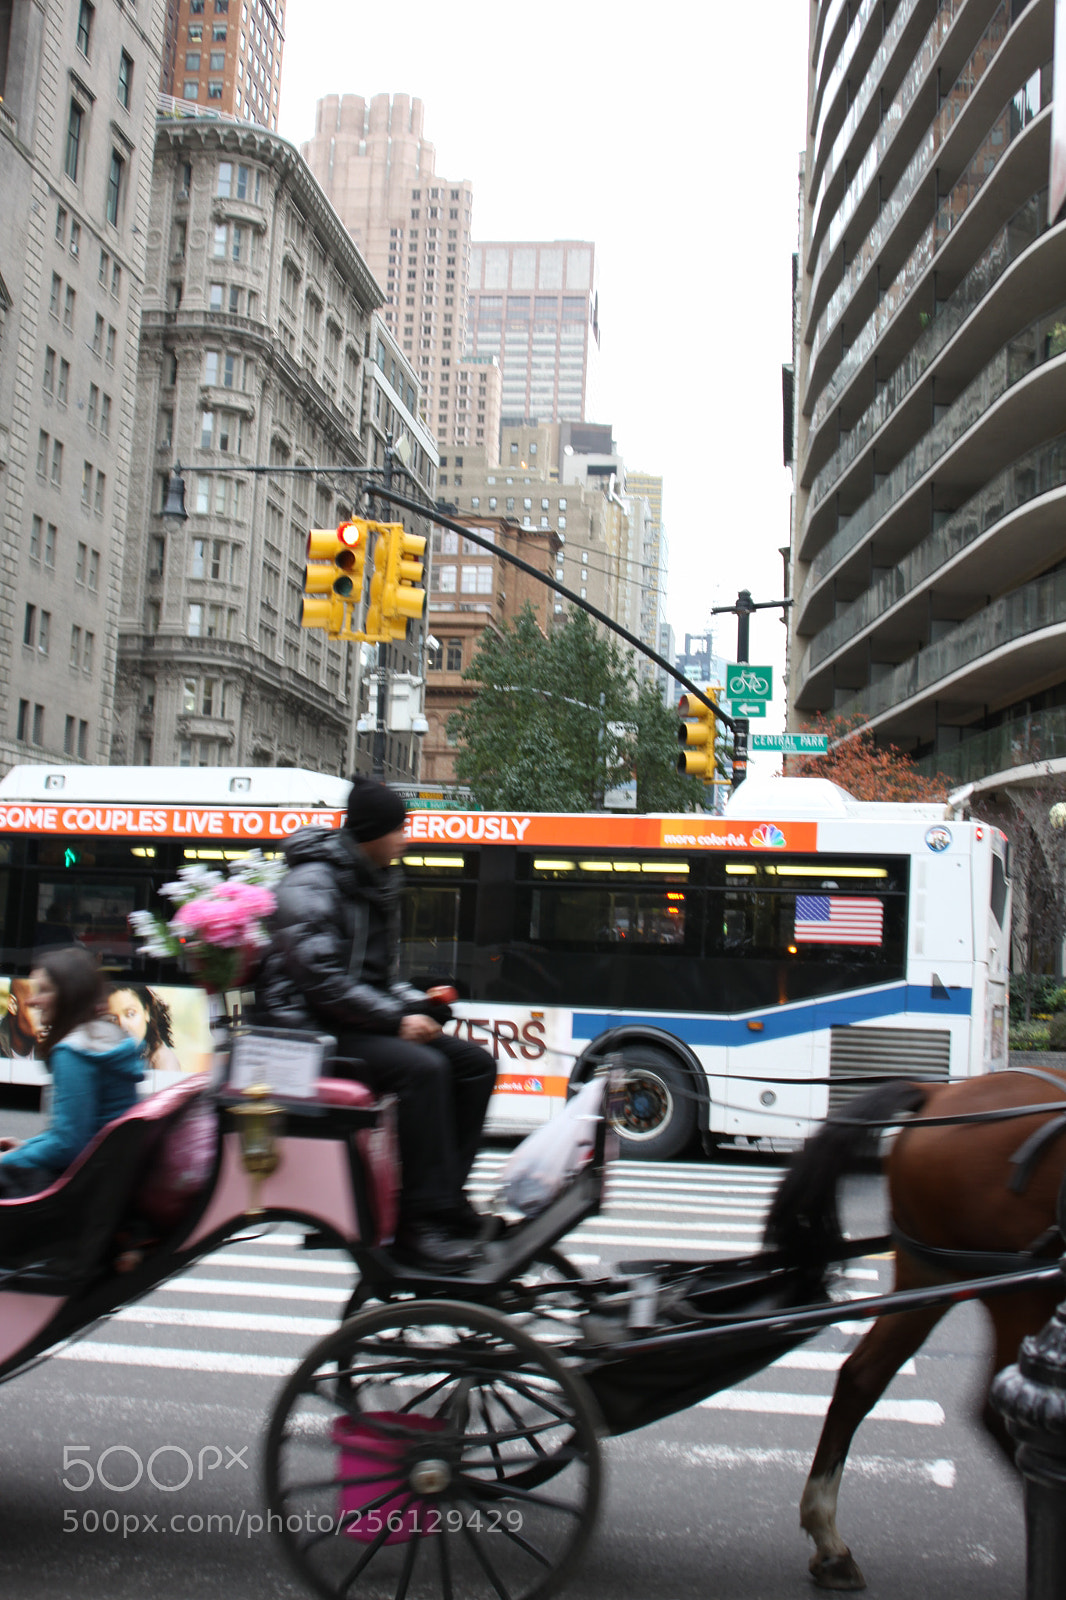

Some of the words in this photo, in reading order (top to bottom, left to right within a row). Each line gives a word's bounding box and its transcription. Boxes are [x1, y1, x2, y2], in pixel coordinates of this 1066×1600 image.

[753, 735, 795, 746] CENTRAL
[800, 736, 825, 747] PARK
[62, 808, 168, 833] COUPLES
[172, 810, 224, 834] LIVE
[228, 812, 263, 836] TO
[664, 833, 697, 846] more
